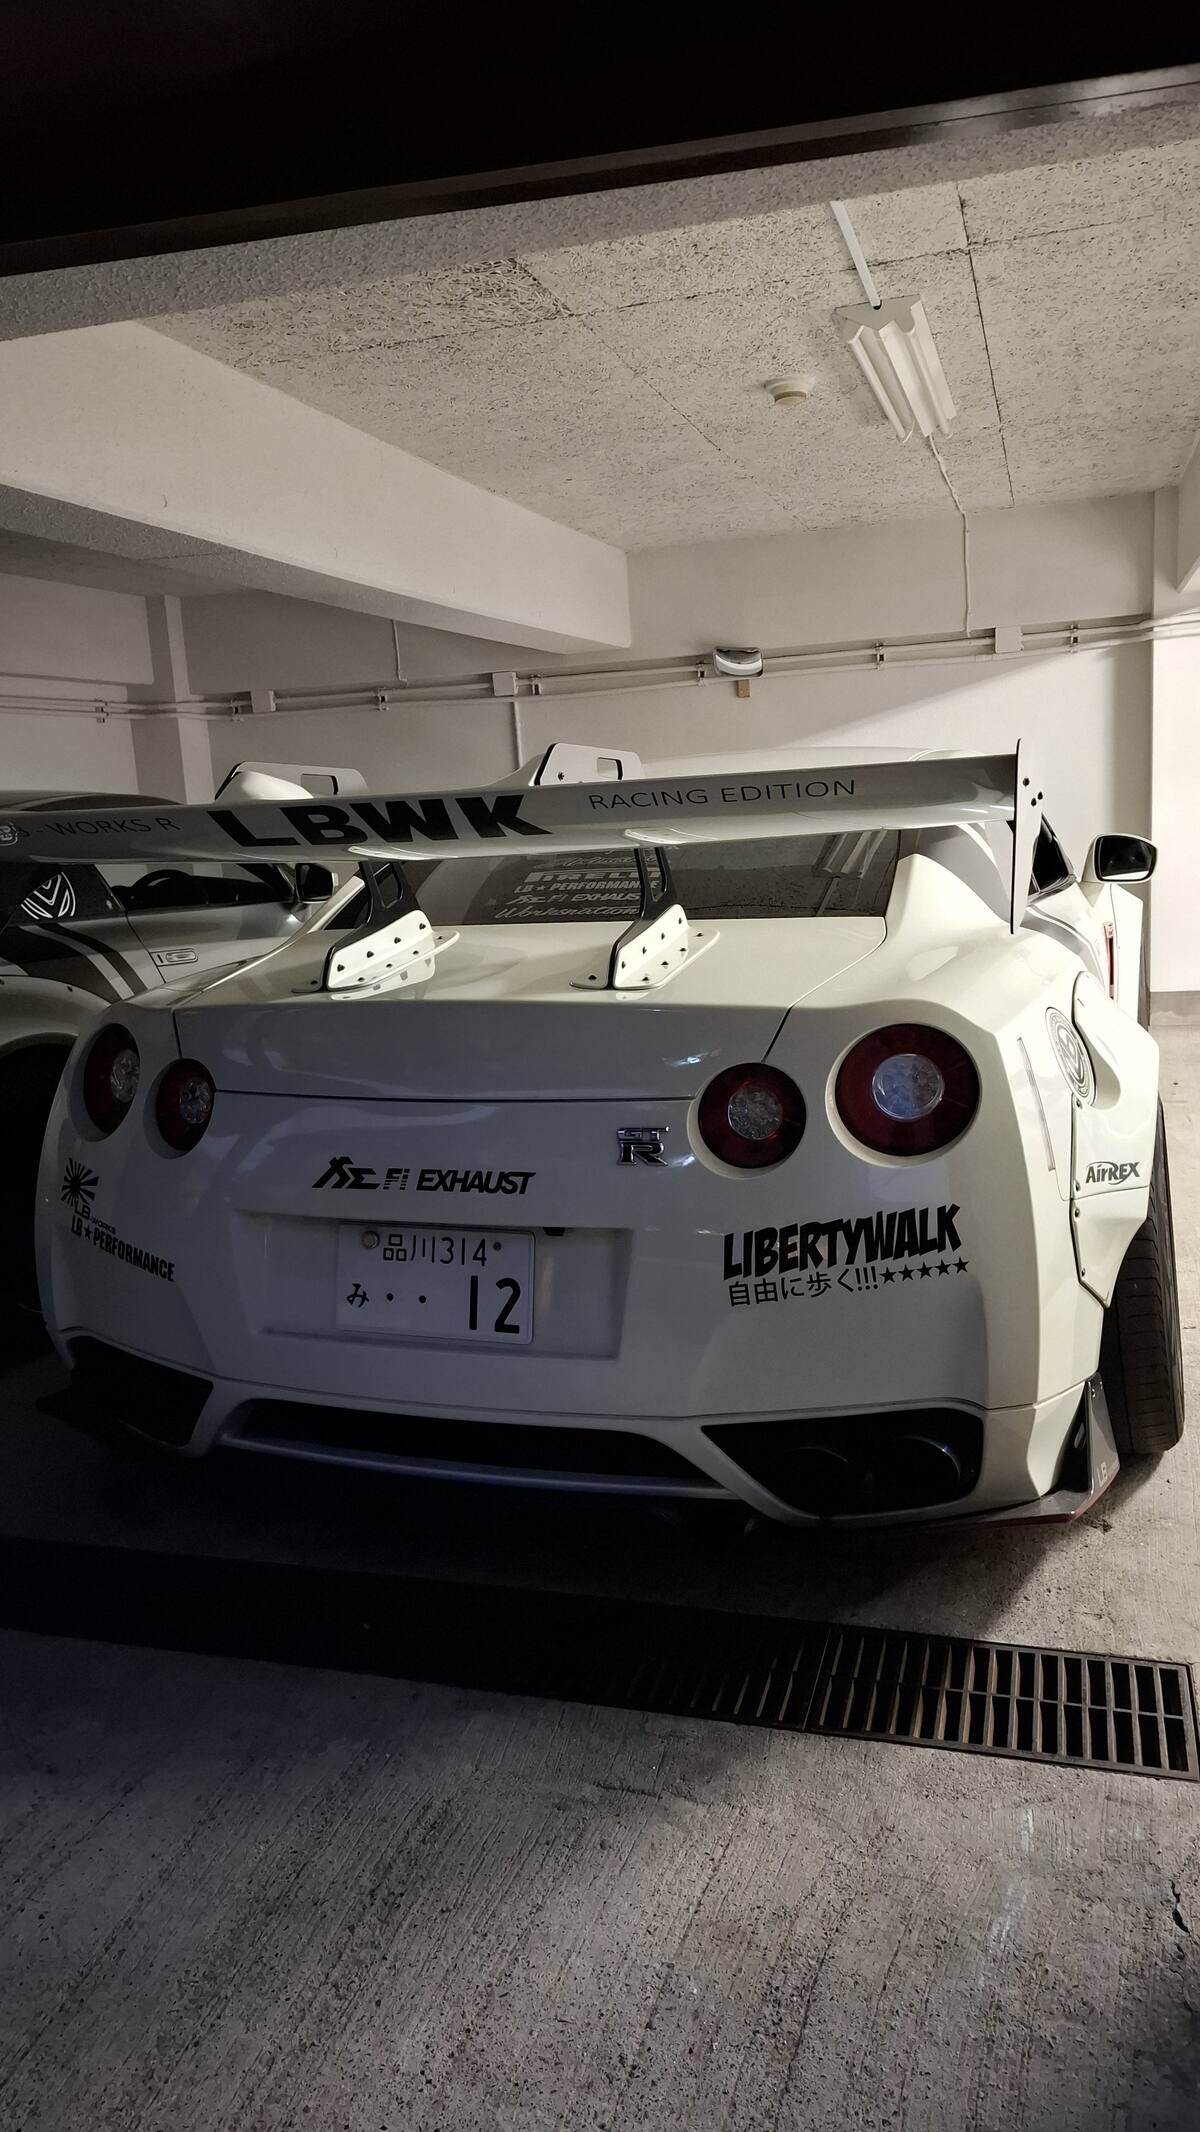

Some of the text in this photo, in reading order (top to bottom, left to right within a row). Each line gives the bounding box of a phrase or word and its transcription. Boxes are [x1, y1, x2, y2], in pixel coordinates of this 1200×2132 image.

[589, 779, 856, 810] RACING EDITION
[45, 818, 151, 836] WORKS
[155, 817, 182, 831] R
[206, 794, 553, 847] LBWK
[550, 880, 660, 892] PERFORMANE
[572, 892, 641, 901] EXHAUS
[416, 1169, 536, 1194] EXHAUST
[74, 1200, 91, 1220] LB
[71, 1214, 175, 1282] LB PERFORMANCE
[723, 1203, 962, 1281] LIBERTYWALK
[469, 1275, 522, 1335] 12
